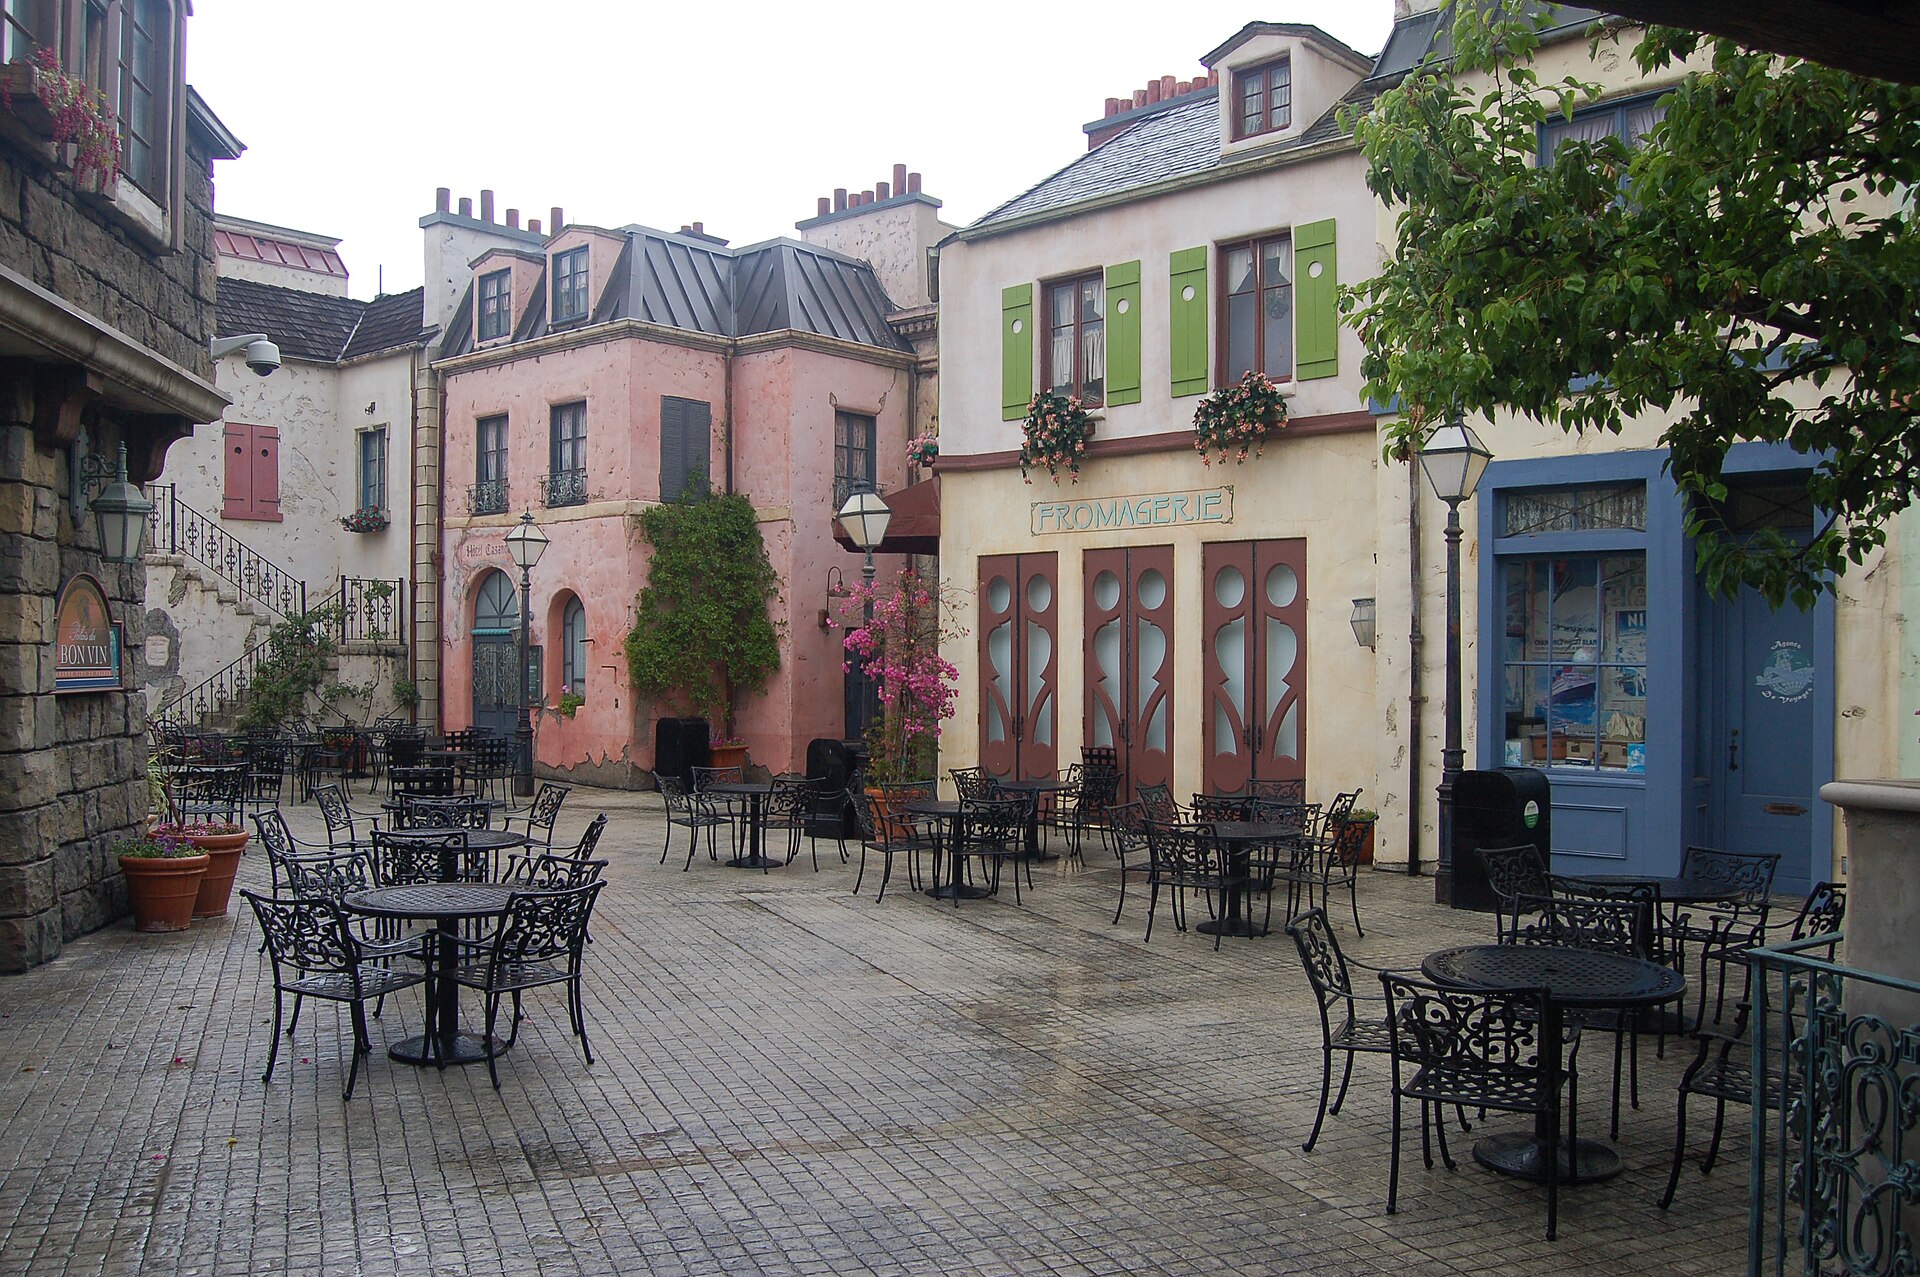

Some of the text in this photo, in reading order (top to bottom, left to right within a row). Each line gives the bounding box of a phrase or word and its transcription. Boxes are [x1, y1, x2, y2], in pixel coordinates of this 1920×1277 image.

[1038, 491, 1223, 532] FROMAGERIE
[61, 644, 107, 665] BON VIN
[1771, 640, 1802, 650] Agence
